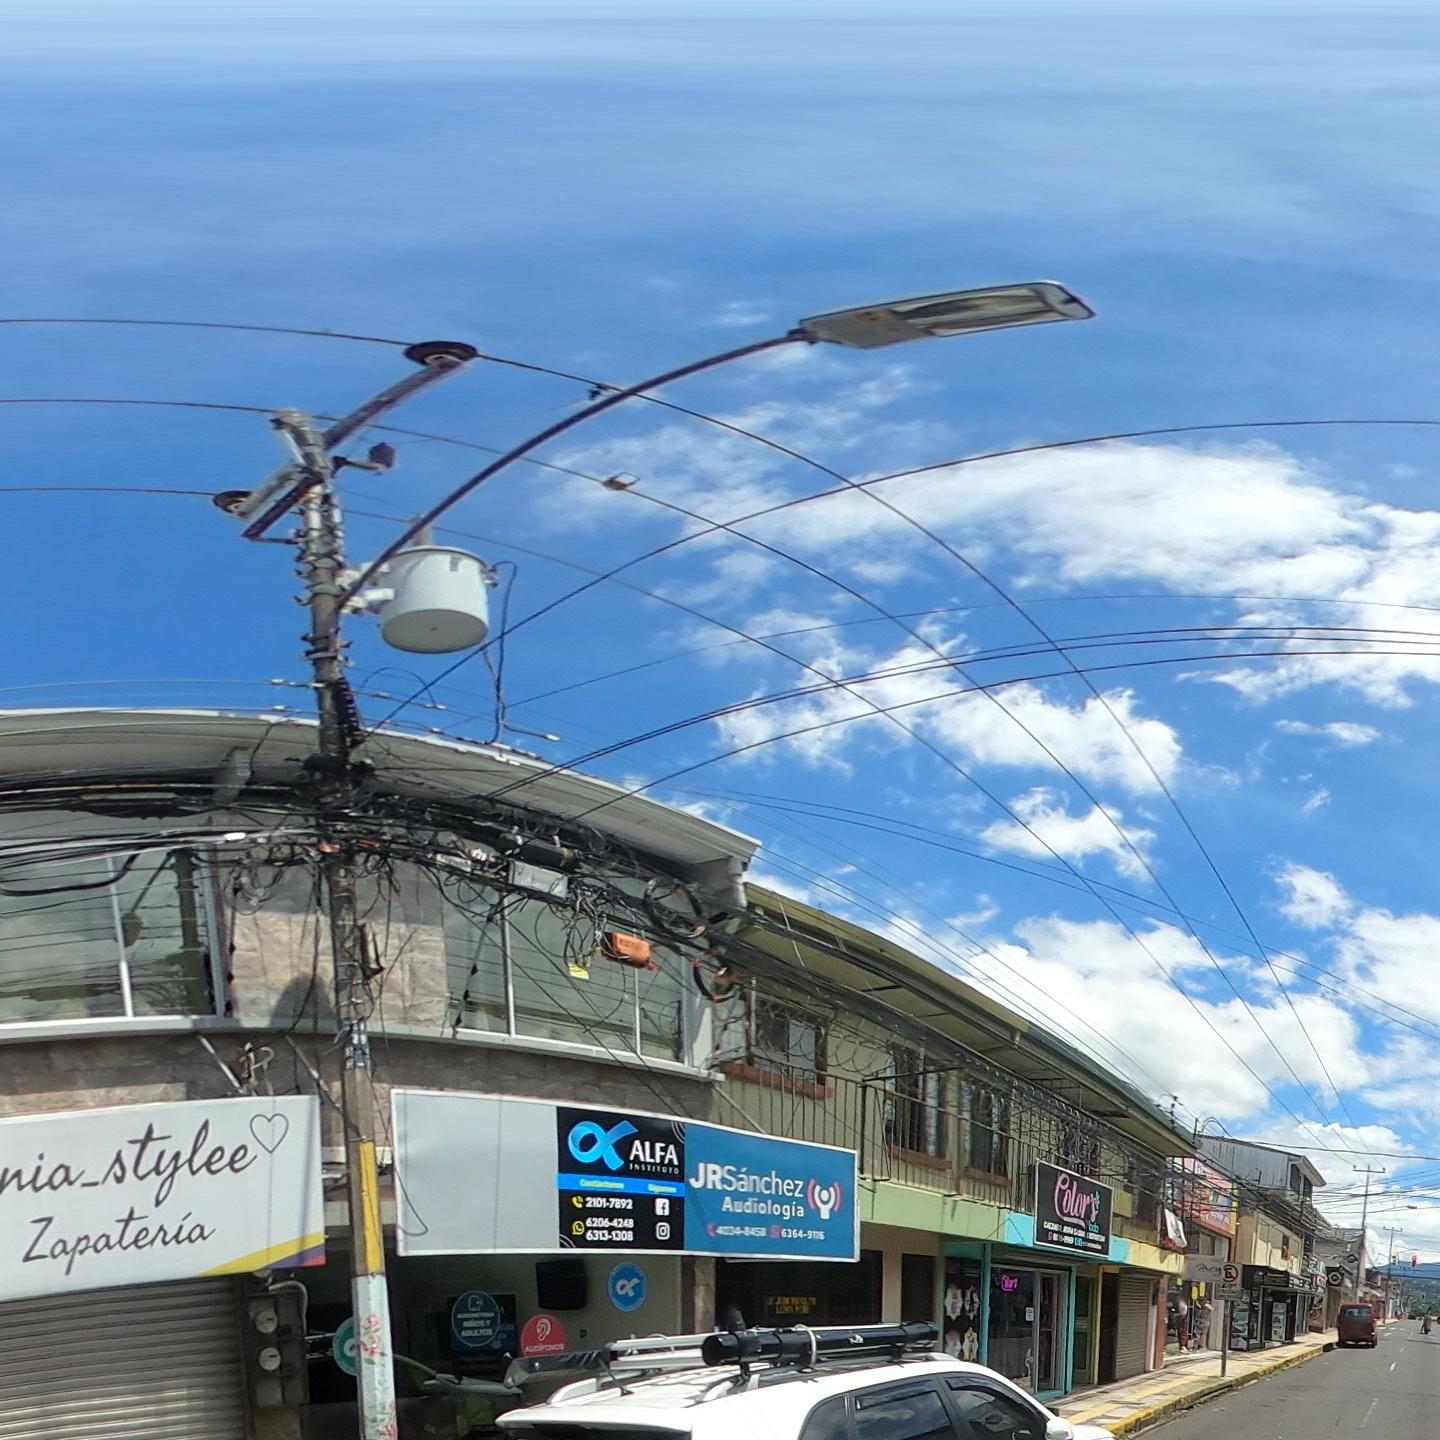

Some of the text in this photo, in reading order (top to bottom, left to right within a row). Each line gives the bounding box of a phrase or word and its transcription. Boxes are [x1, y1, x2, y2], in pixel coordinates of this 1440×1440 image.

[629, 1139, 679, 1166] ALFA
[629, 1163, 680, 1175] INSTITUTO
[722, 1196, 804, 1220] Audiología
[22, 1206, 216, 1276] Zapatería
